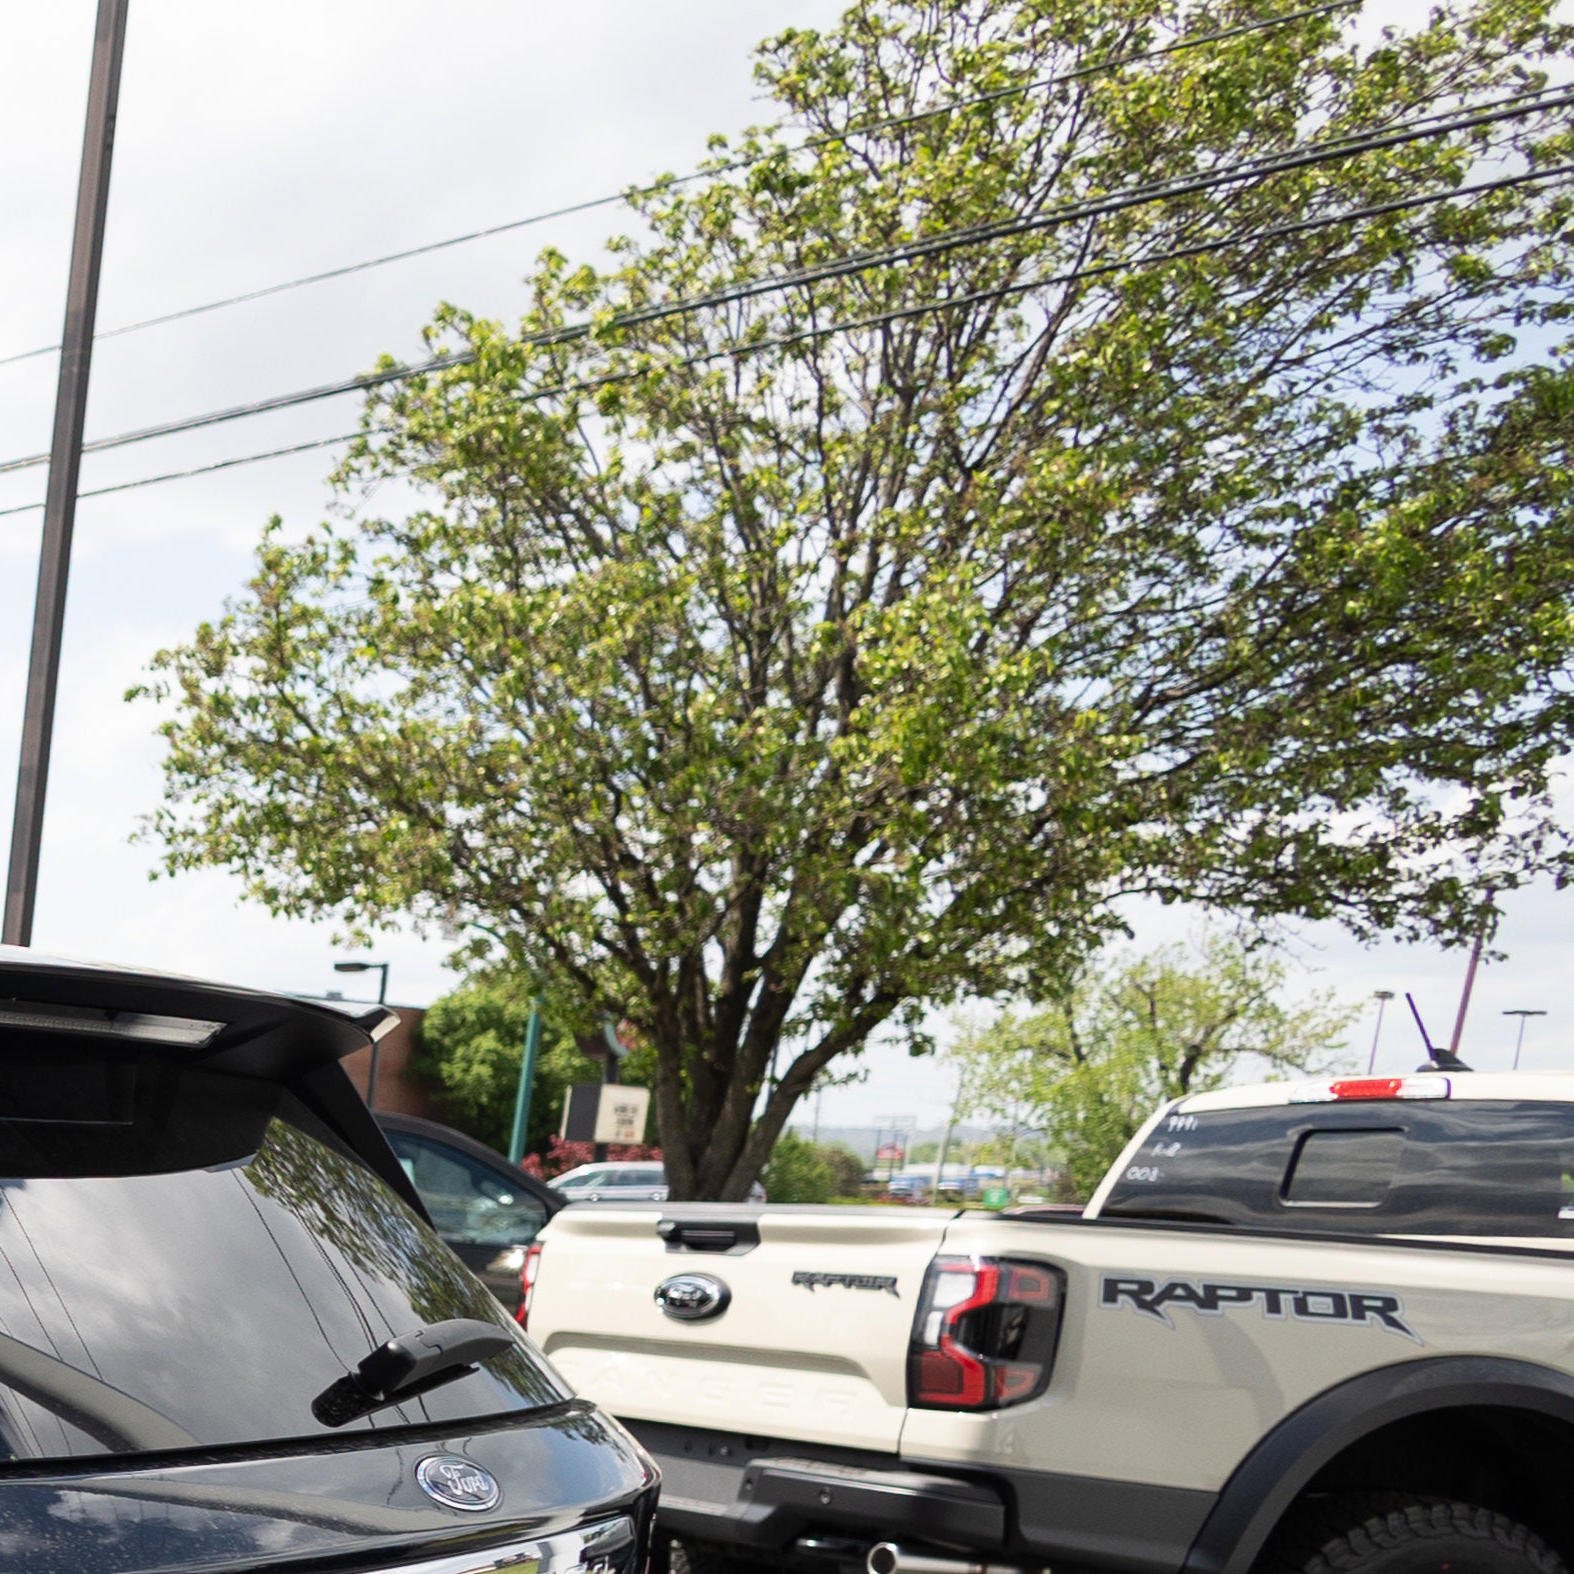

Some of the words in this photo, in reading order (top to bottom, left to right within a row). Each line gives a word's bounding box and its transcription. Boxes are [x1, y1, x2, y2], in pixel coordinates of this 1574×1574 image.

[791, 1271, 901, 1300] RAPTOR
[1100, 1274, 1423, 1346] RAPTOR
[439, 1462, 489, 1496] Ford
